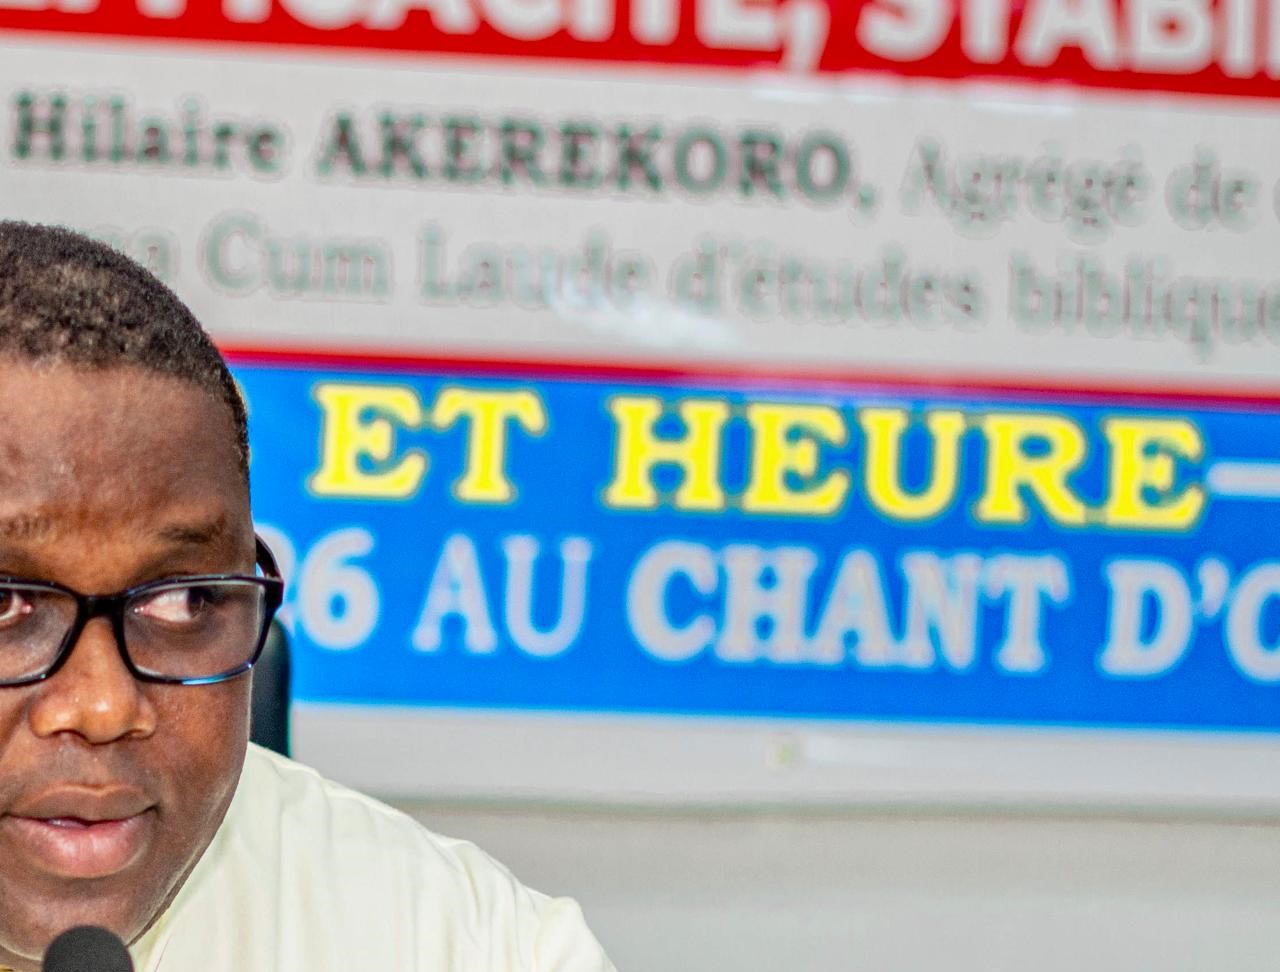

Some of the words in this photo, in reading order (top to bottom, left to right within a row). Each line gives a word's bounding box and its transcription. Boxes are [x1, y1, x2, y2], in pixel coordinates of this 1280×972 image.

[11, 91, 286, 174] Hilaire
[320, 112, 880, 212] AKEREKORO,
[907, 136, 1150, 236] Agrégé
[1168, 148, 1260, 228] de
[203, 212, 392, 296] Cum
[418, 226, 652, 310] Laude
[312, 384, 544, 503] ET
[606, 397, 1206, 530] HEURE
[412, 533, 591, 657] AU
[626, 540, 1070, 674] CHANT
